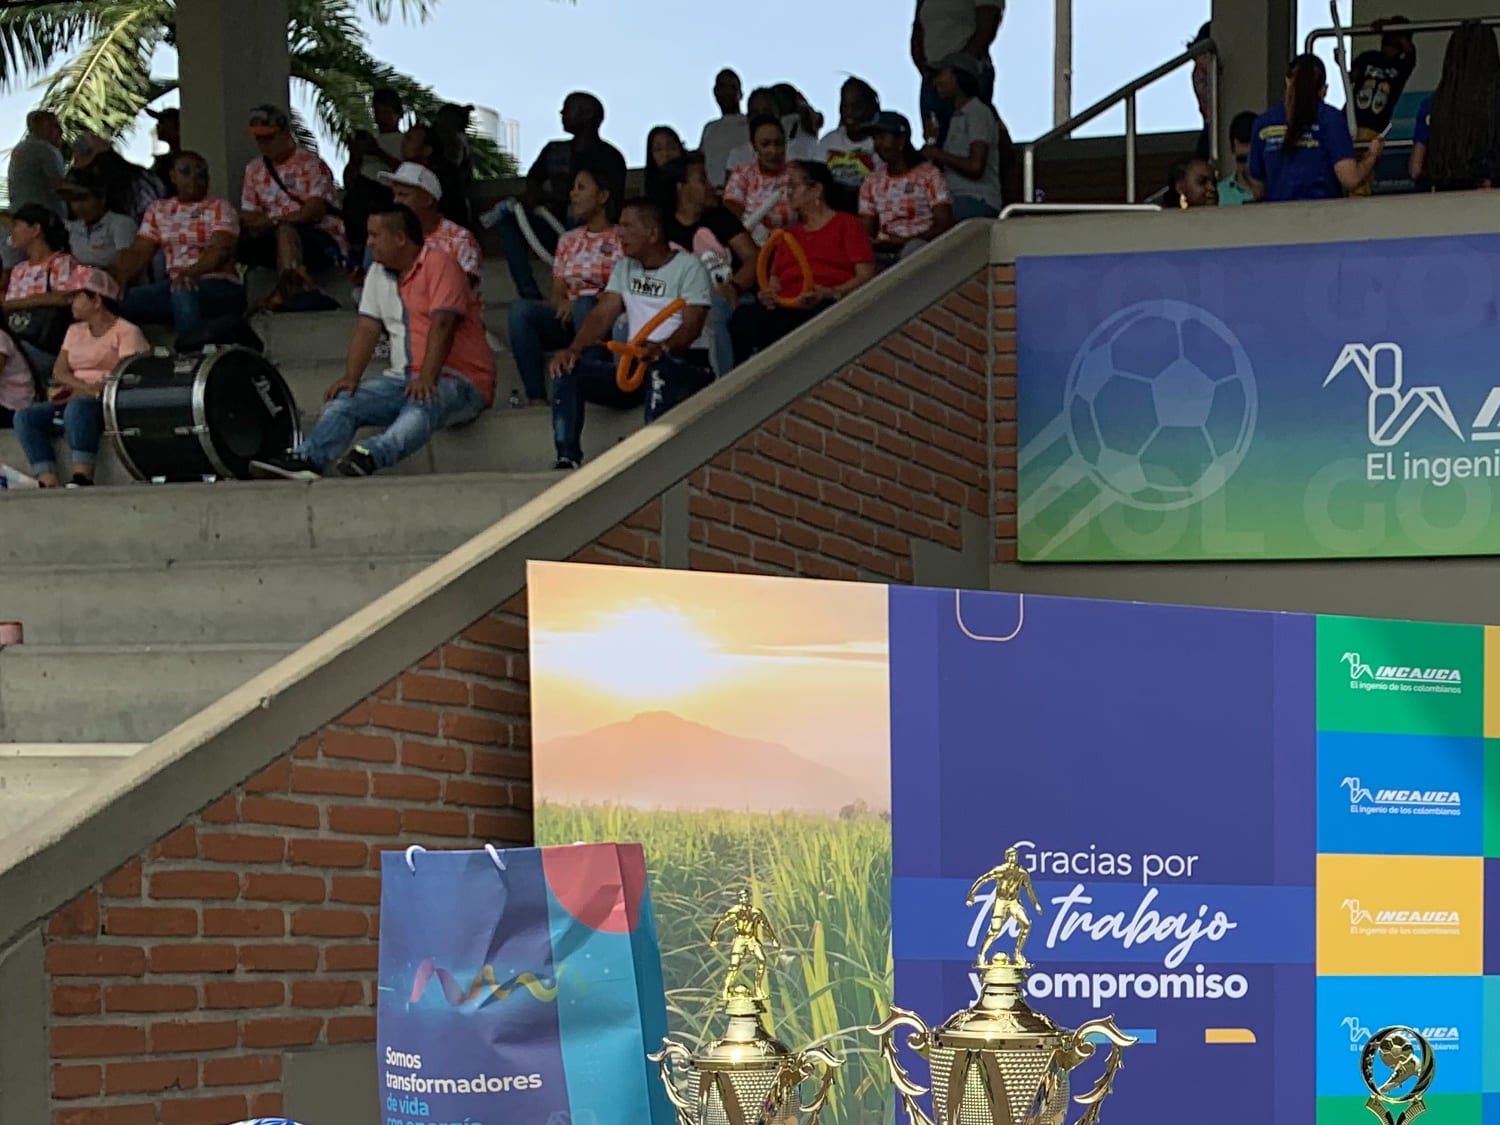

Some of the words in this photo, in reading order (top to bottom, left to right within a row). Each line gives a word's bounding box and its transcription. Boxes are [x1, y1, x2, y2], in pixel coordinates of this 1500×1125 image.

[1366, 453, 1395, 480] El
[1376, 666, 1460, 680] INCAUCA
[1360, 682, 1386, 690] ingenio
[1413, 685, 1461, 693] colombianos
[1376, 790, 1460, 802] INCAUCA
[1142, 850, 1199, 885] por
[1046, 884, 1237, 969] trabajo
[1376, 911, 1459, 922] INCAUCA
[1024, 964, 1249, 1008] ompromiso
[386, 1046, 422, 1069] Somos
[386, 1071, 543, 1094] transformadores
[386, 1093, 398, 1112] de
[399, 1096, 430, 1116] vida
